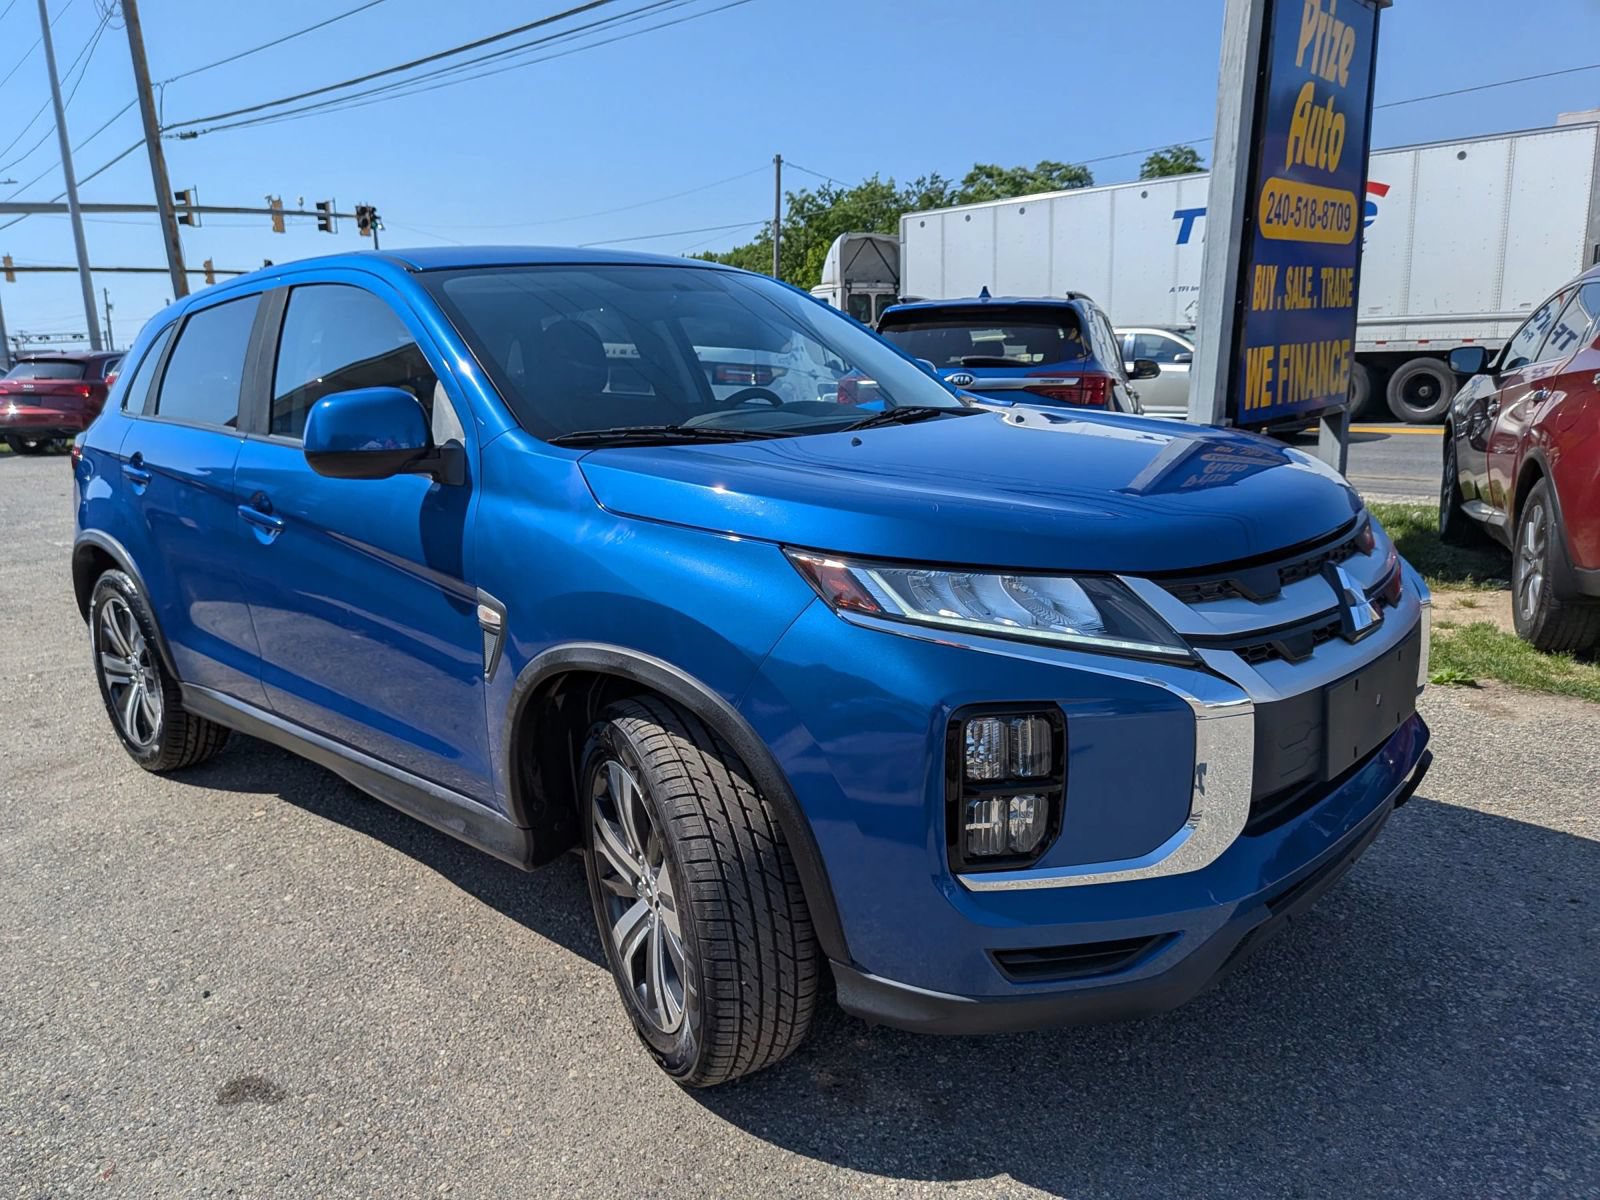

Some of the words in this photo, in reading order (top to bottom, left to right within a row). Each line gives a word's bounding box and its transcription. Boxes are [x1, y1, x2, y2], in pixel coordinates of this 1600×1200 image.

[1296, 0, 1356, 88] Prize
[1285, 81, 1345, 173] Auto
[1265, 191, 1351, 232] 240-518-8709
[1252, 264, 1278, 311] BUY
[1285, 266, 1313, 311] SALE
[1321, 267, 1354, 308] TRADE
[953, 375, 971, 385] KIA
[1244, 345, 1275, 411] WE
[1276, 339, 1351, 405] FINANCE
